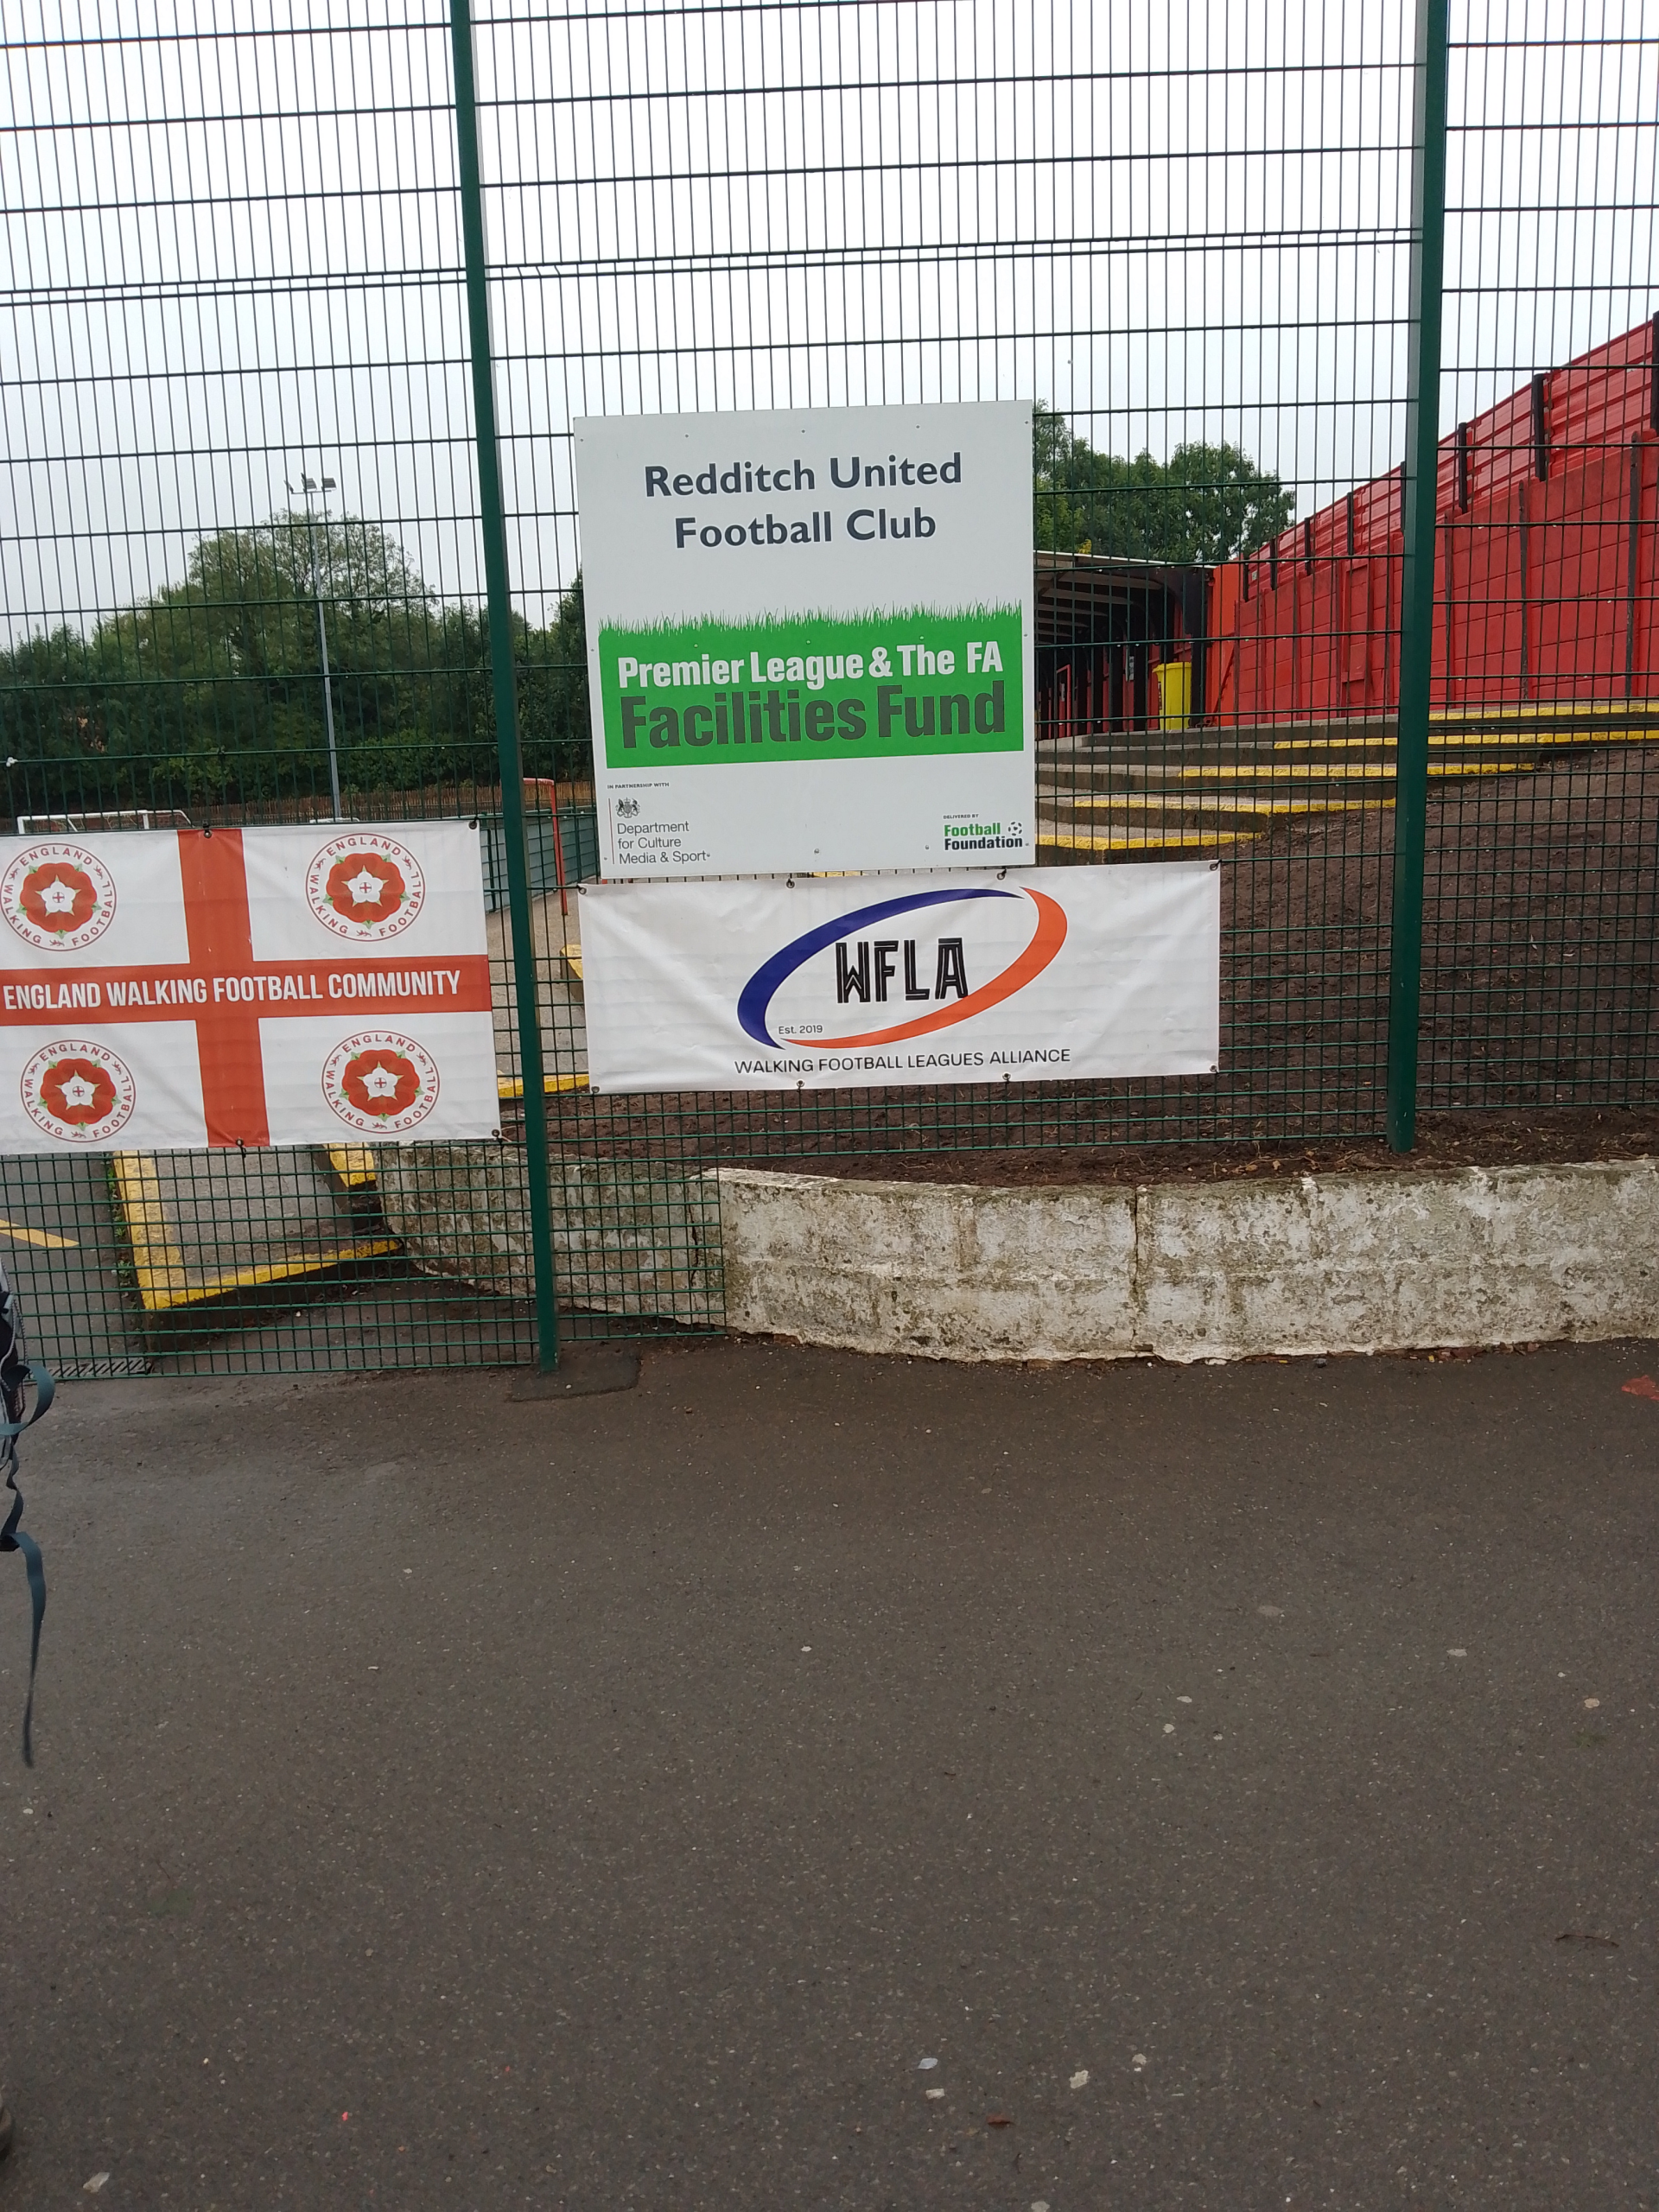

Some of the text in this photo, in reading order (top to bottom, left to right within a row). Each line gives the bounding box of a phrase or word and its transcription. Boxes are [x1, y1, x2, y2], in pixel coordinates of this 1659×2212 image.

[645, 452, 962, 497] Redditch United
[675, 507, 937, 548] Football Club
[618, 641, 1003, 690] Premier League & The FA
[620, 680, 1005, 749] Facilities Fund
[326, 836, 401, 856] ENGLAND
[617, 821, 690, 836] Department
[618, 836, 682, 849] for Culture
[944, 823, 1001, 836] Football
[944, 836, 1023, 850] Foundation
[19, 846, 92, 867] ENGLAND
[620, 850, 707, 864] Media & Sport
[3, 884, 41, 944] WALKING
[71, 880, 113, 946] FOOTBALL
[309, 874, 348, 933] WALKING
[378, 871, 422, 937] FOOTBALL
[3, 970, 461, 1009] ENGLAND WALKING FOOTBALL COMMUNITY
[836, 938, 969, 1003] WFLA
[341, 1034, 416, 1053] ENGLAND
[779, 1025, 823, 1034] Est. 2019
[39, 1043, 110, 1061] ENGLAND
[734, 1049, 1071, 1074] WALKING FOOTBALL LEAGUES ALLIANCE
[24, 1078, 63, 1135] WALKING
[92, 1076, 132, 1138] FOOTBALL
[325, 1070, 364, 1126] WALKING
[394, 1067, 435, 1128] FOOTBALL
